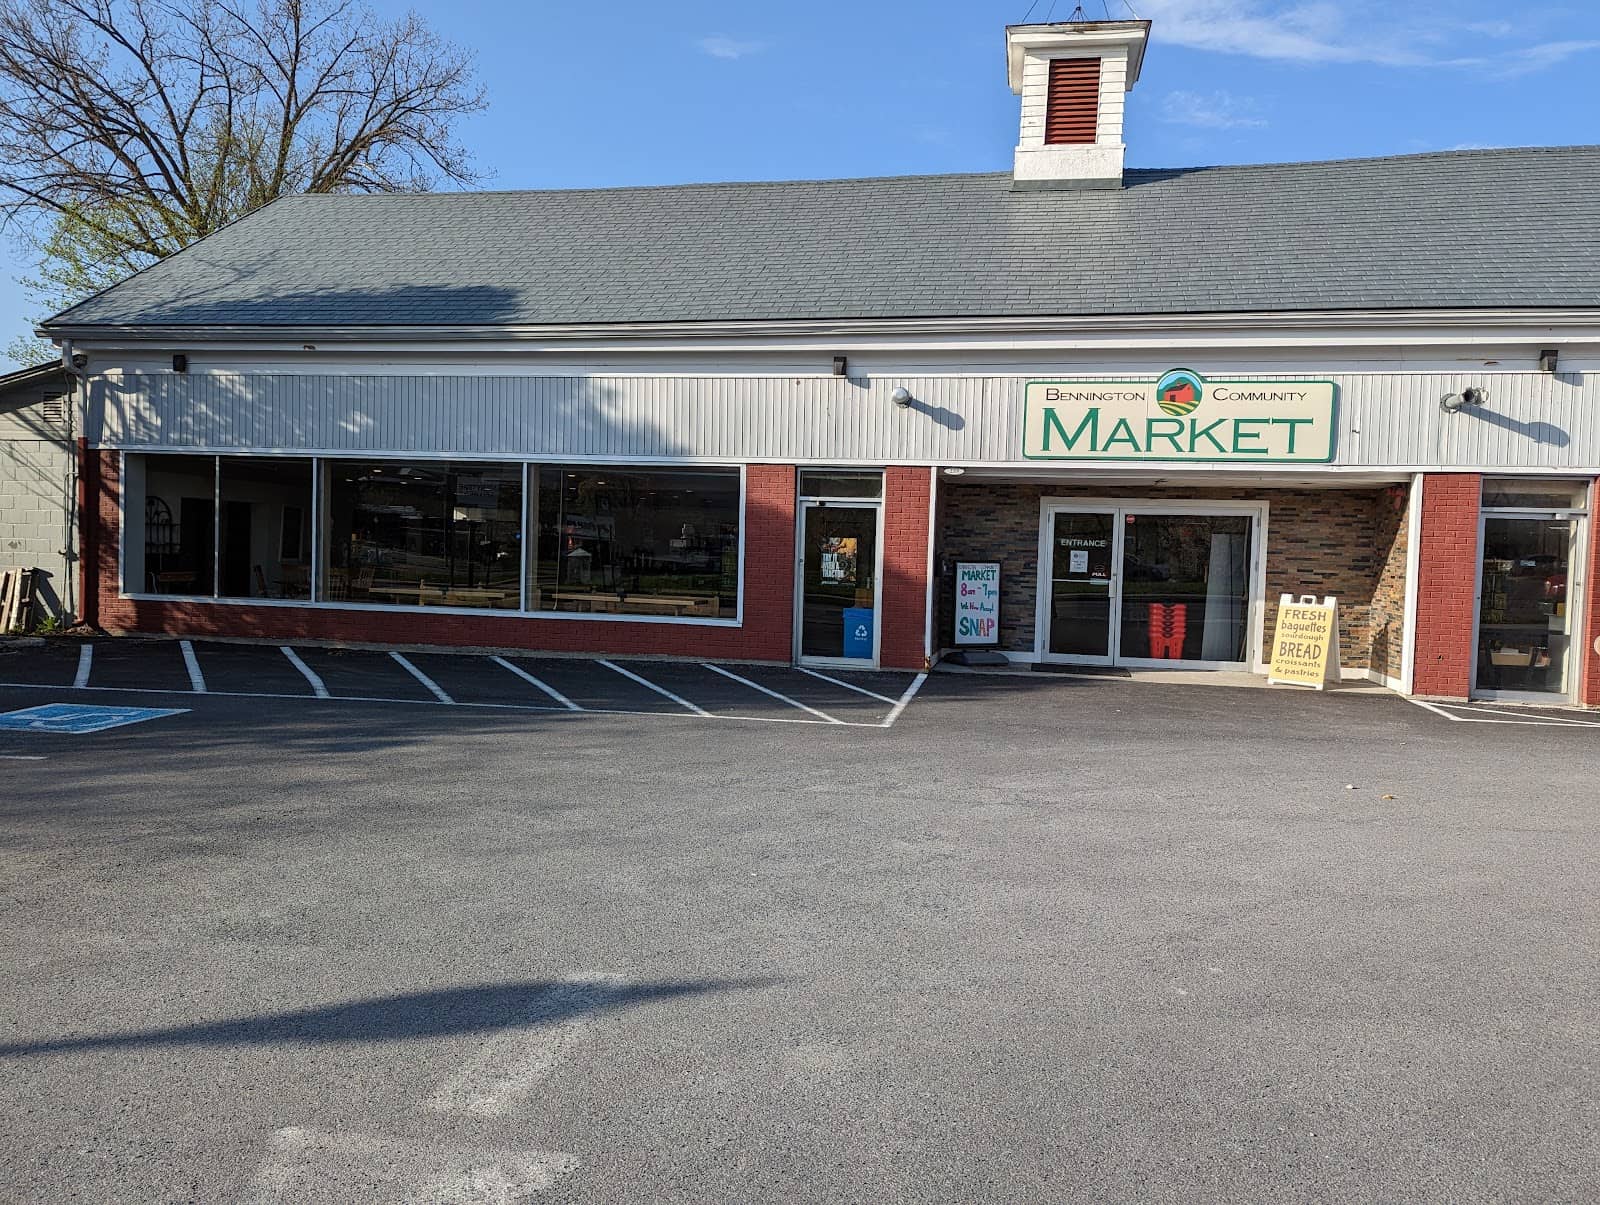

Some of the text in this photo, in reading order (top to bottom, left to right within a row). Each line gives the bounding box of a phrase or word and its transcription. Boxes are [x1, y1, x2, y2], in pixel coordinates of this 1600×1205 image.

[1046, 388, 1307, 401] BENNINGTON COMMUNITY
[1040, 407, 1314, 454] MARKET
[1060, 538, 1107, 547] ENTRANCE
[962, 570, 996, 580] MARKET
[1285, 609, 1326, 621] FRESH
[959, 616, 995, 637] SNAP
[1282, 620, 1326, 633] baguettes
[1282, 633, 1323, 642] sourdough
[1280, 642, 1321, 659] BREAD
[1276, 659, 1320, 668] croissants
[1285, 668, 1319, 677] pastries
